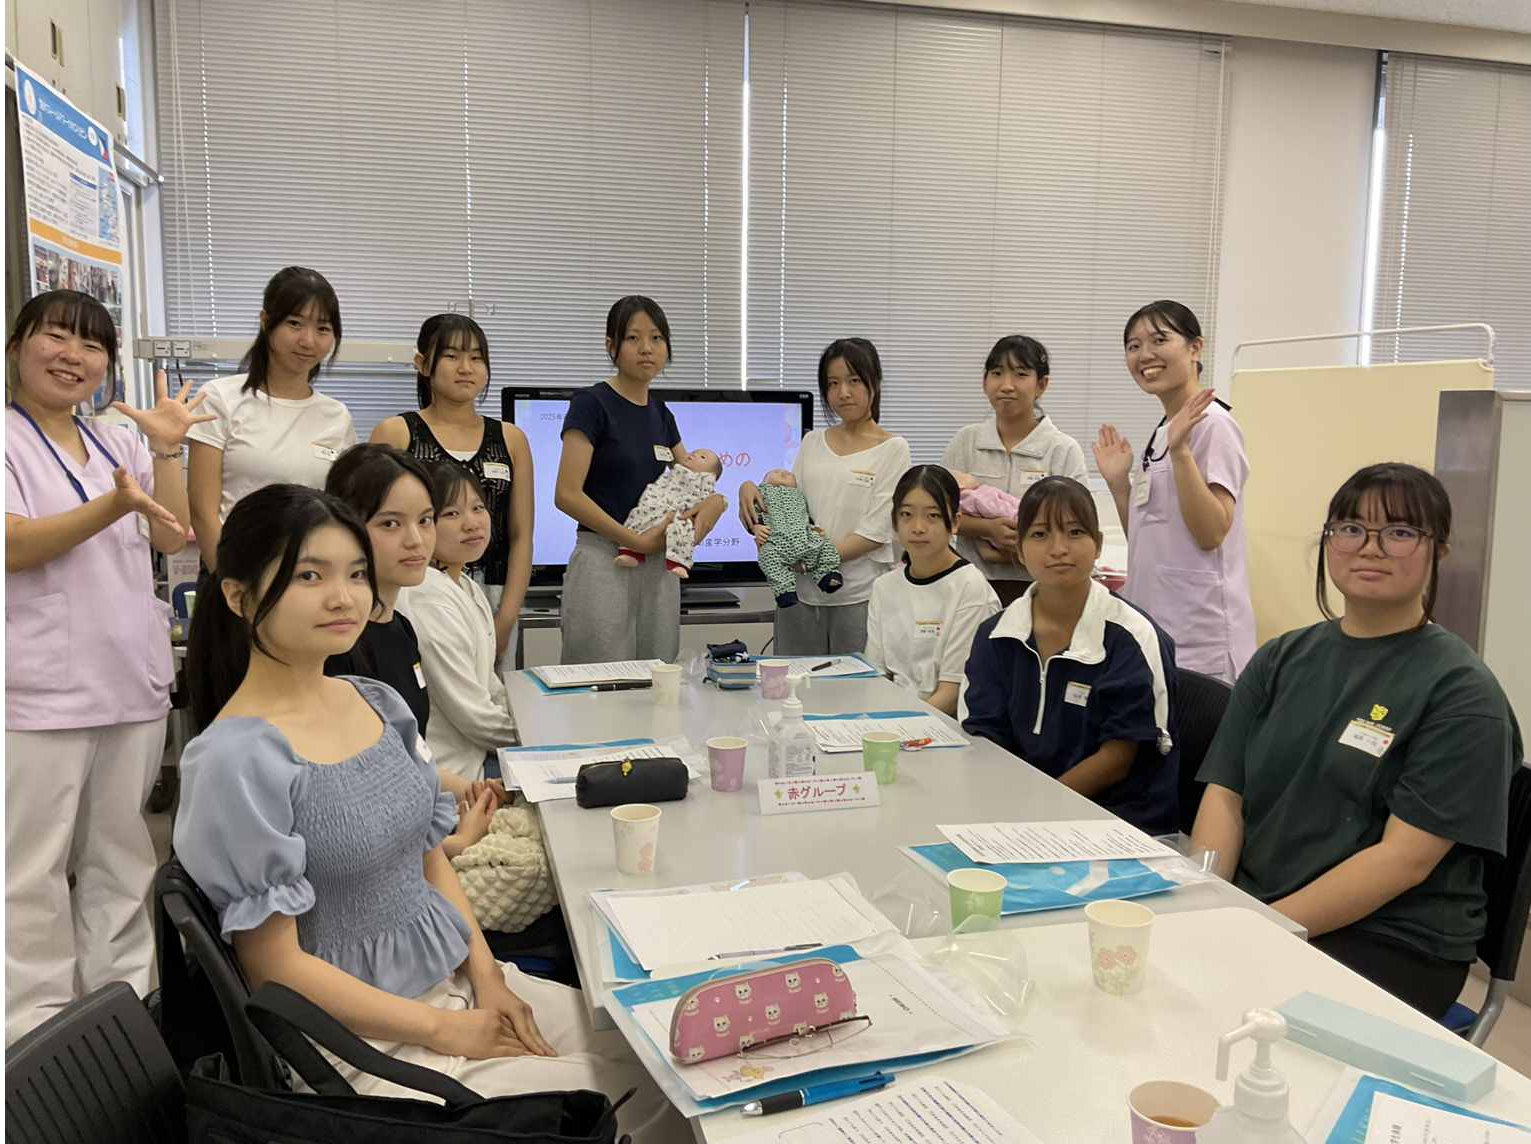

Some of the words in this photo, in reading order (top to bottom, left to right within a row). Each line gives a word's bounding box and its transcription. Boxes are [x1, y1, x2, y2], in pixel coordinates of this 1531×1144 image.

[787, 783, 847, 800] 赤グループ
